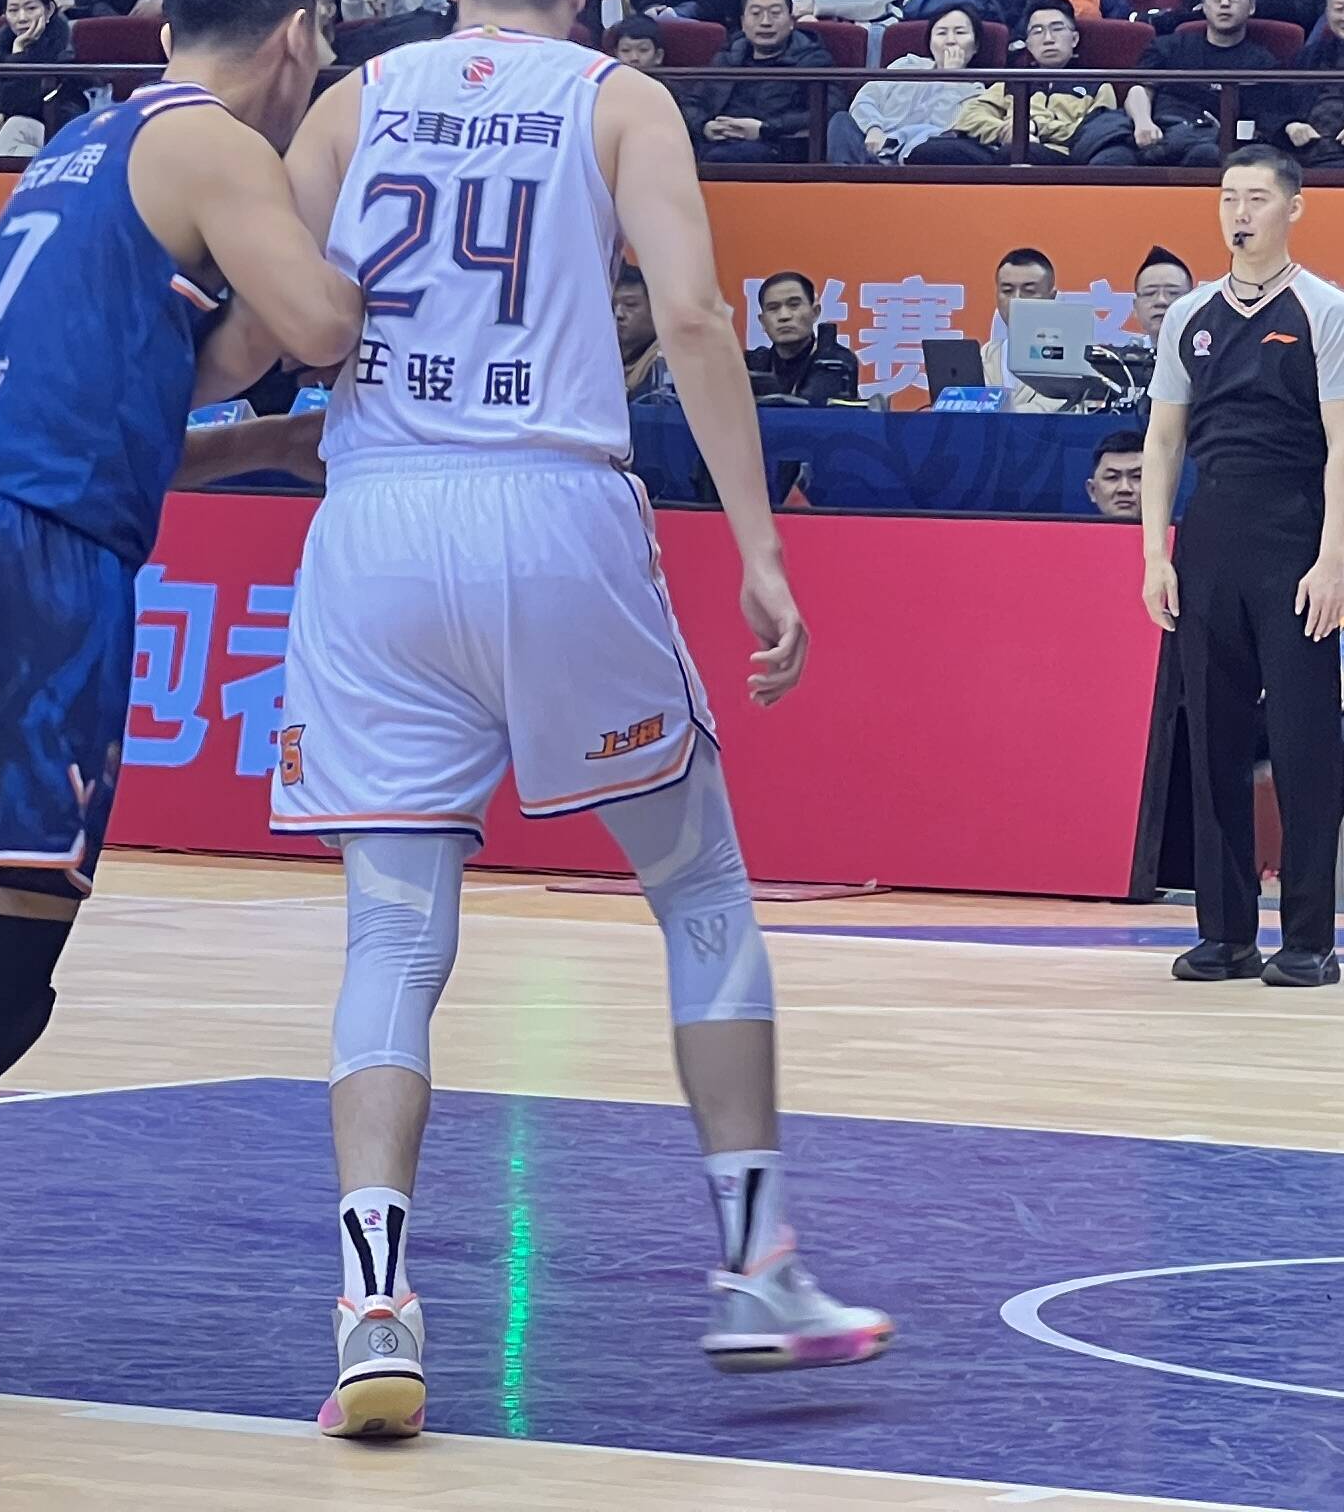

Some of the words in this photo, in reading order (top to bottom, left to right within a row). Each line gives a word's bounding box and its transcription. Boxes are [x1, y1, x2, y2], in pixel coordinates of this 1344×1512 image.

[369, 110, 564, 149] 久事体育
[13, 143, 108, 195] 东高速
[359, 172, 538, 326] 24
[356, 339, 532, 407] 王骏威
